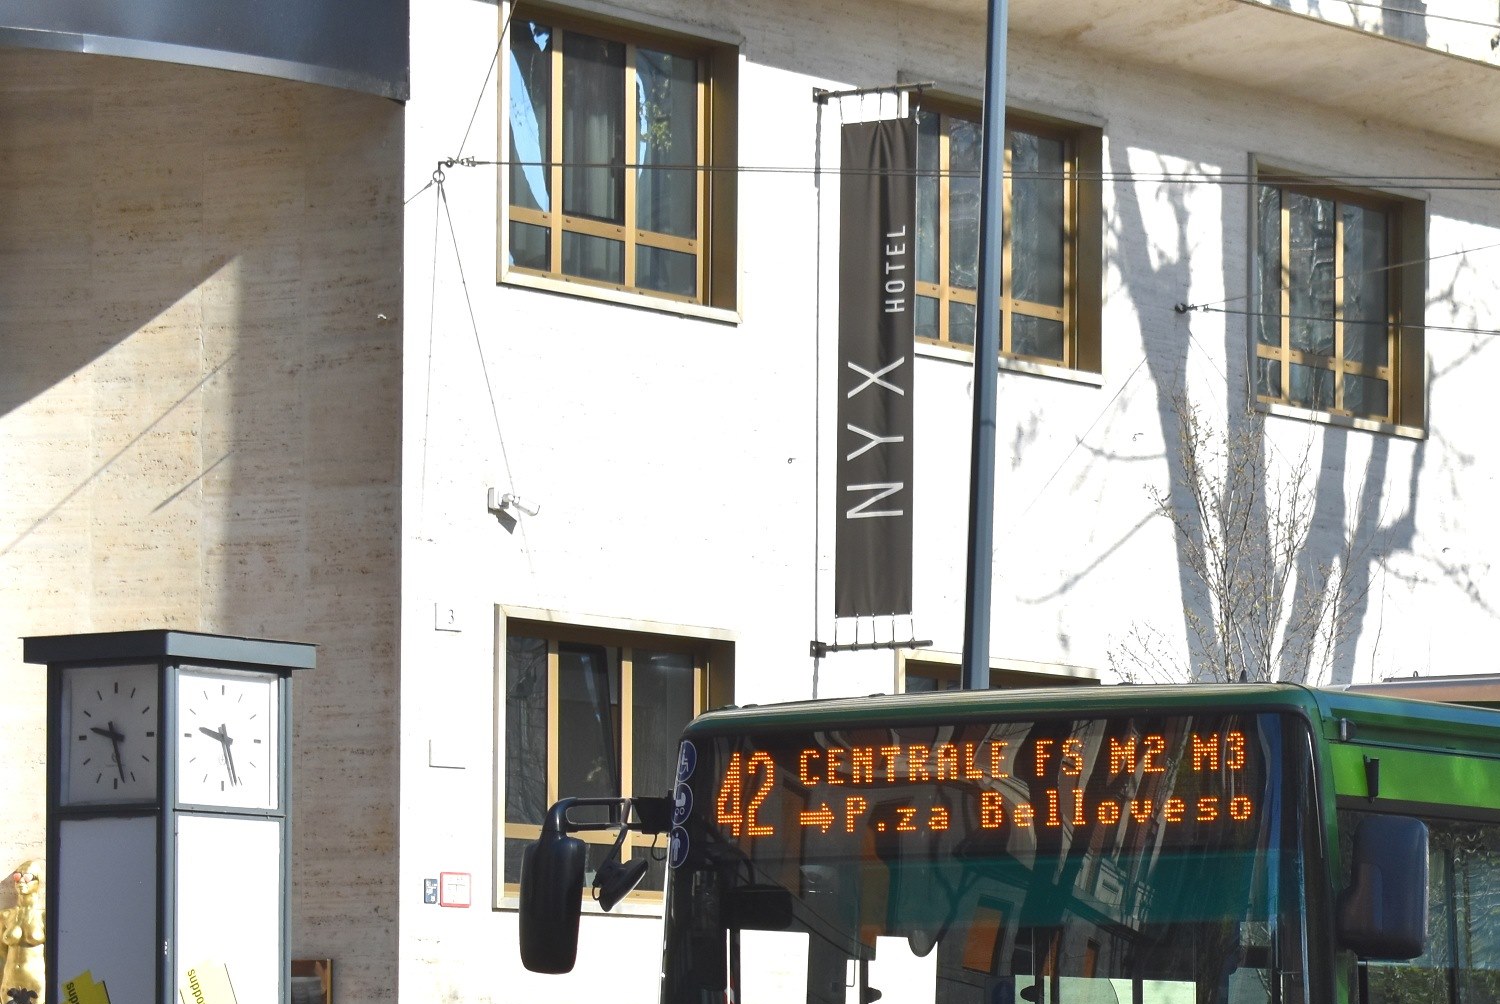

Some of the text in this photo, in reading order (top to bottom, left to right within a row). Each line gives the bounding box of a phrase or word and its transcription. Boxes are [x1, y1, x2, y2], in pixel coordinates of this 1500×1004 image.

[885, 225, 906, 313] HOTEL
[846, 356, 906, 520] NYX
[717, 752, 774, 836] 42
[800, 731, 1245, 786] CENTRALE FS M2 M3
[846, 788, 1251, 833] P.za Belloveso
